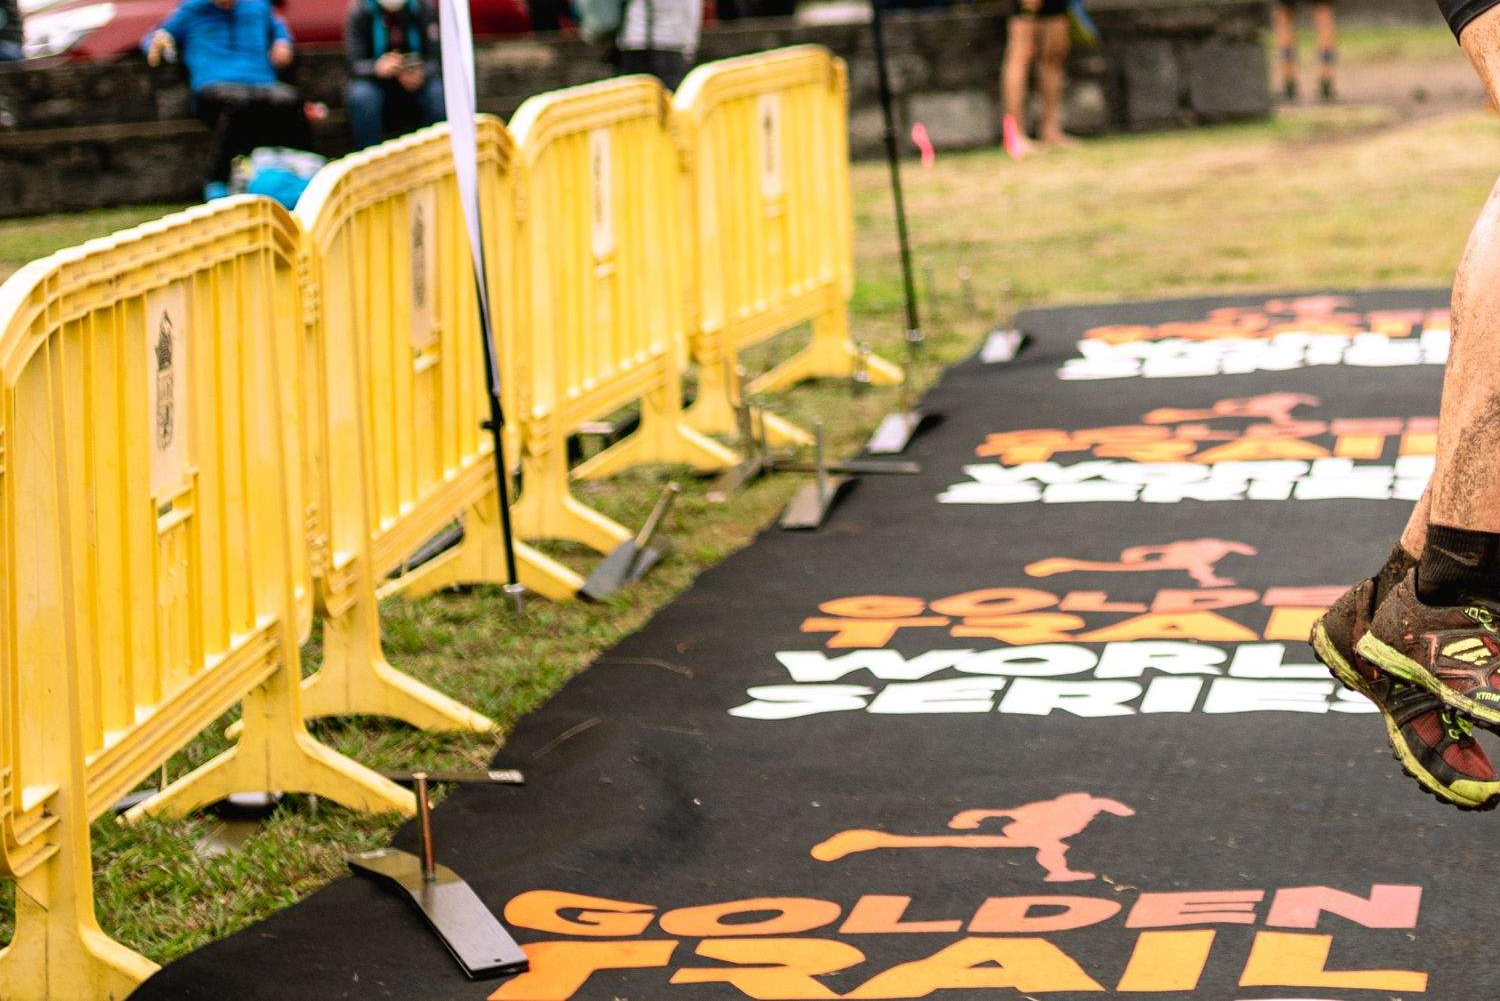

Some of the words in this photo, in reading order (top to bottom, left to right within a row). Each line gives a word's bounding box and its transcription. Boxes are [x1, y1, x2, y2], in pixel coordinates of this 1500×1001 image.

[818, 585, 1352, 620] GOLDE
[800, 606, 1326, 649] TRAI
[775, 640, 1334, 683] WORL
[503, 884, 1423, 938] GOLDEN
[486, 929, 1429, 1001] TRAIL
